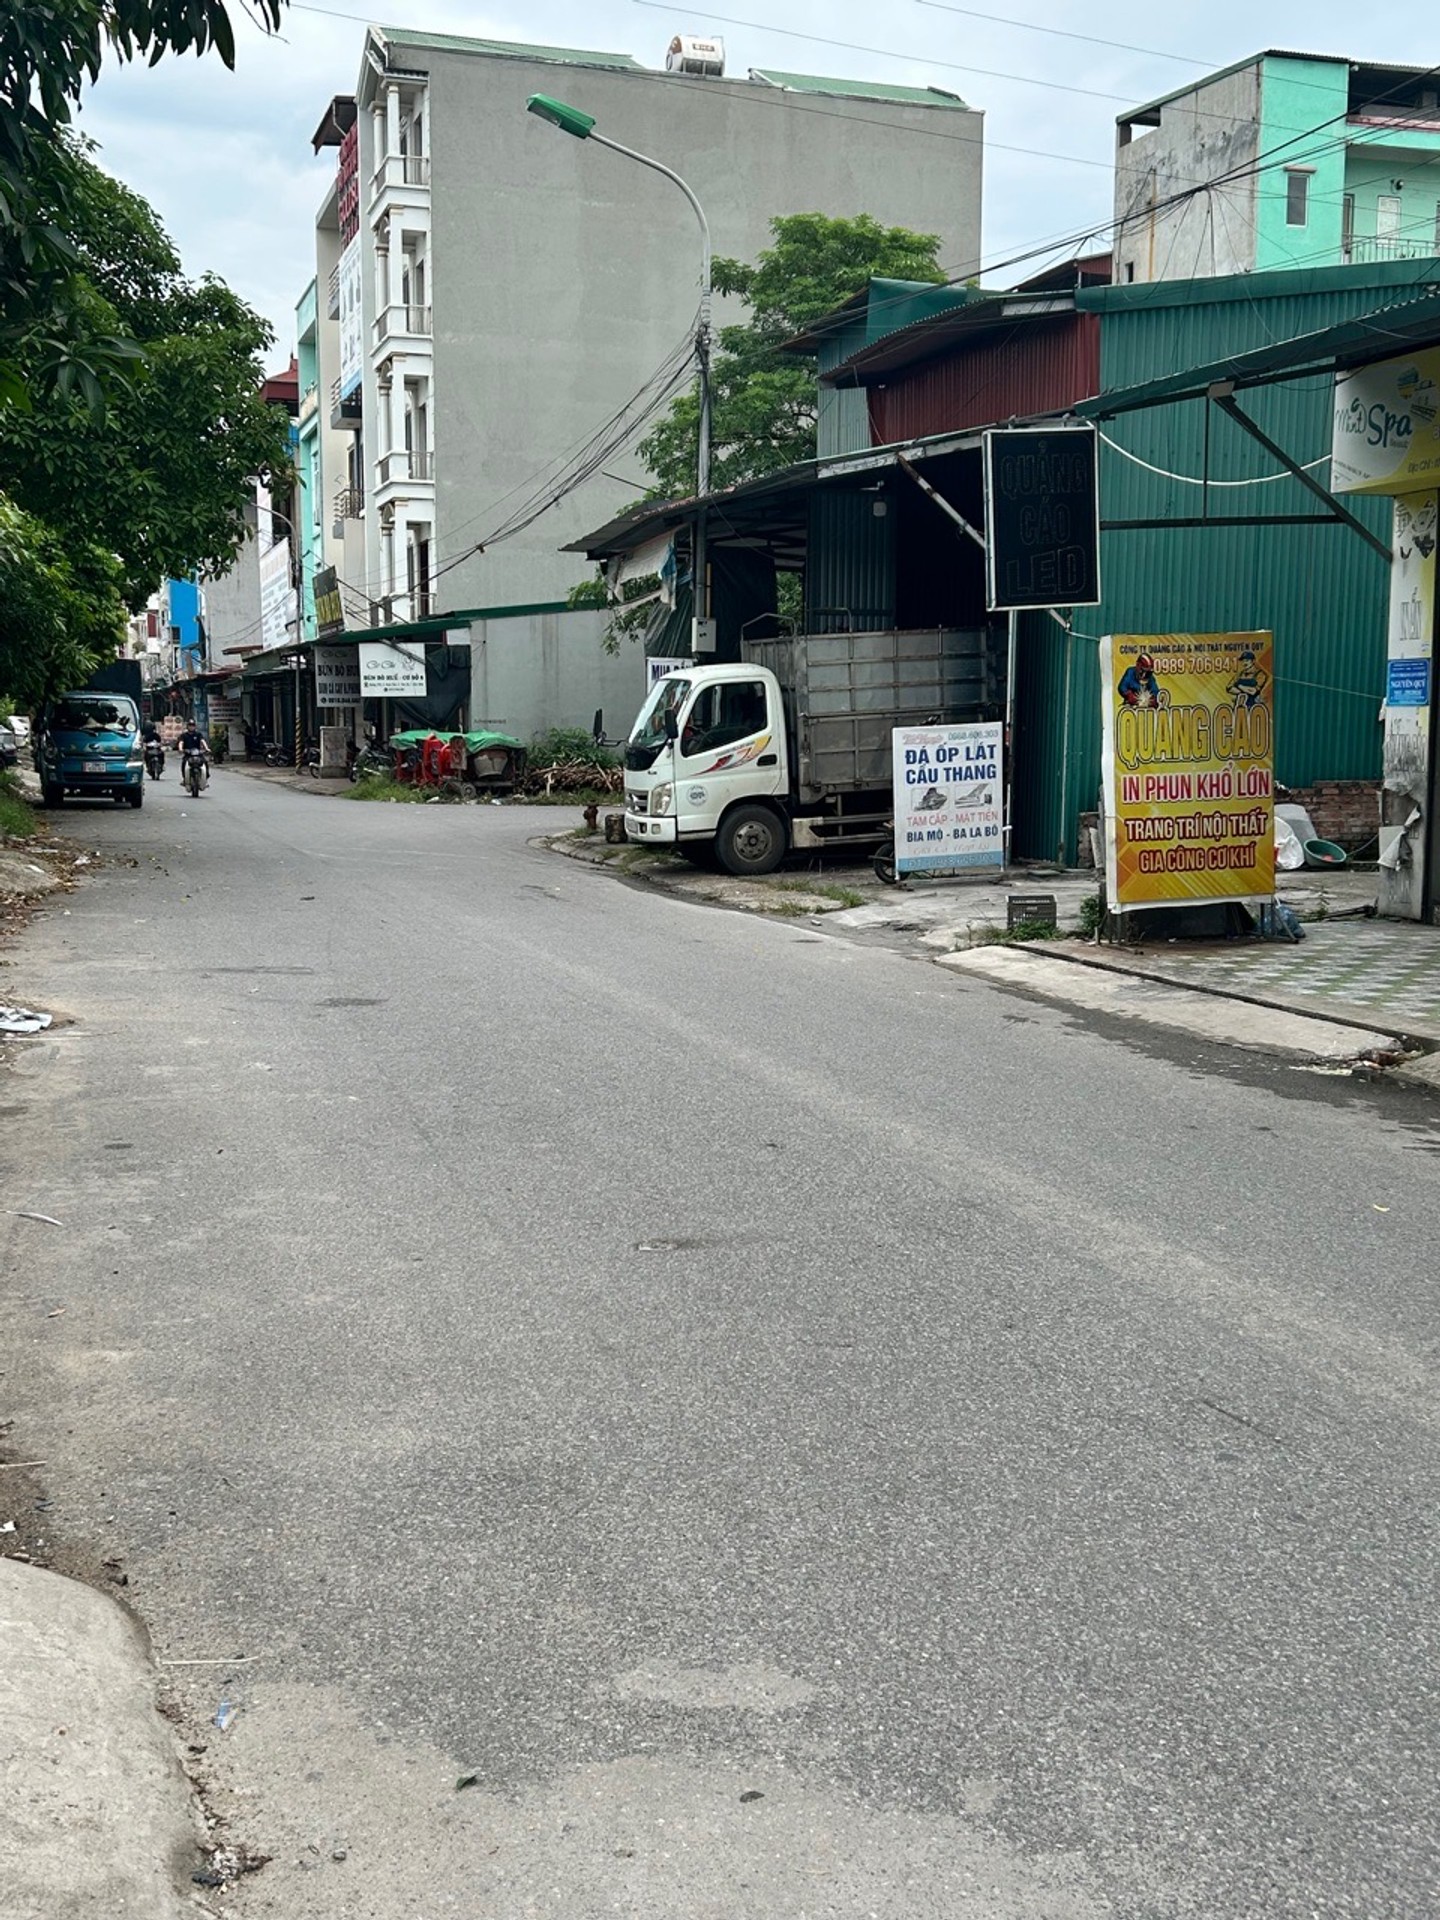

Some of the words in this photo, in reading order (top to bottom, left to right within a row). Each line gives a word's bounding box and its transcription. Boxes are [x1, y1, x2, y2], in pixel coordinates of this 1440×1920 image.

[1367, 403, 1412, 448] Spa
[1001, 440, 1087, 500] QUẢNG
[1020, 495, 1071, 545] CÁO
[1006, 545, 1085, 597] LED
[1153, 658, 1185, 675] 0989
[1189, 657, 1212, 674] 706
[1213, 656, 1239, 673] 941
[1118, 690, 1211, 769] QUẢNG
[1213, 694, 1270, 760] CÁO
[905, 745, 930, 765] ĐÁ
[936, 742, 960, 763] ỐP
[966, 741, 997, 761] LÁT
[943, 763, 997, 783] THANG
[1123, 776, 1140, 800] IN
[1145, 773, 1192, 800] PHUN
[1197, 762, 1232, 798] KHỔ
[1237, 767, 1270, 796] LỚN
[907, 831, 924, 843] BIA
[926, 827, 943, 842] MỘ
[953, 828, 967, 840] BA
[969, 827, 982, 838] LA
[1126, 818, 1174, 841] TRANG
[1176, 812, 1200, 839] TRÍ
[1202, 811, 1227, 841] NỘI
[1230, 806, 1267, 836] THẤT
[1139, 850, 1166, 873] GIA
[1166, 845, 1205, 870] CÔNG
[1207, 847, 1229, 869] CƠ
[1230, 842, 1257, 868] KHÍ
